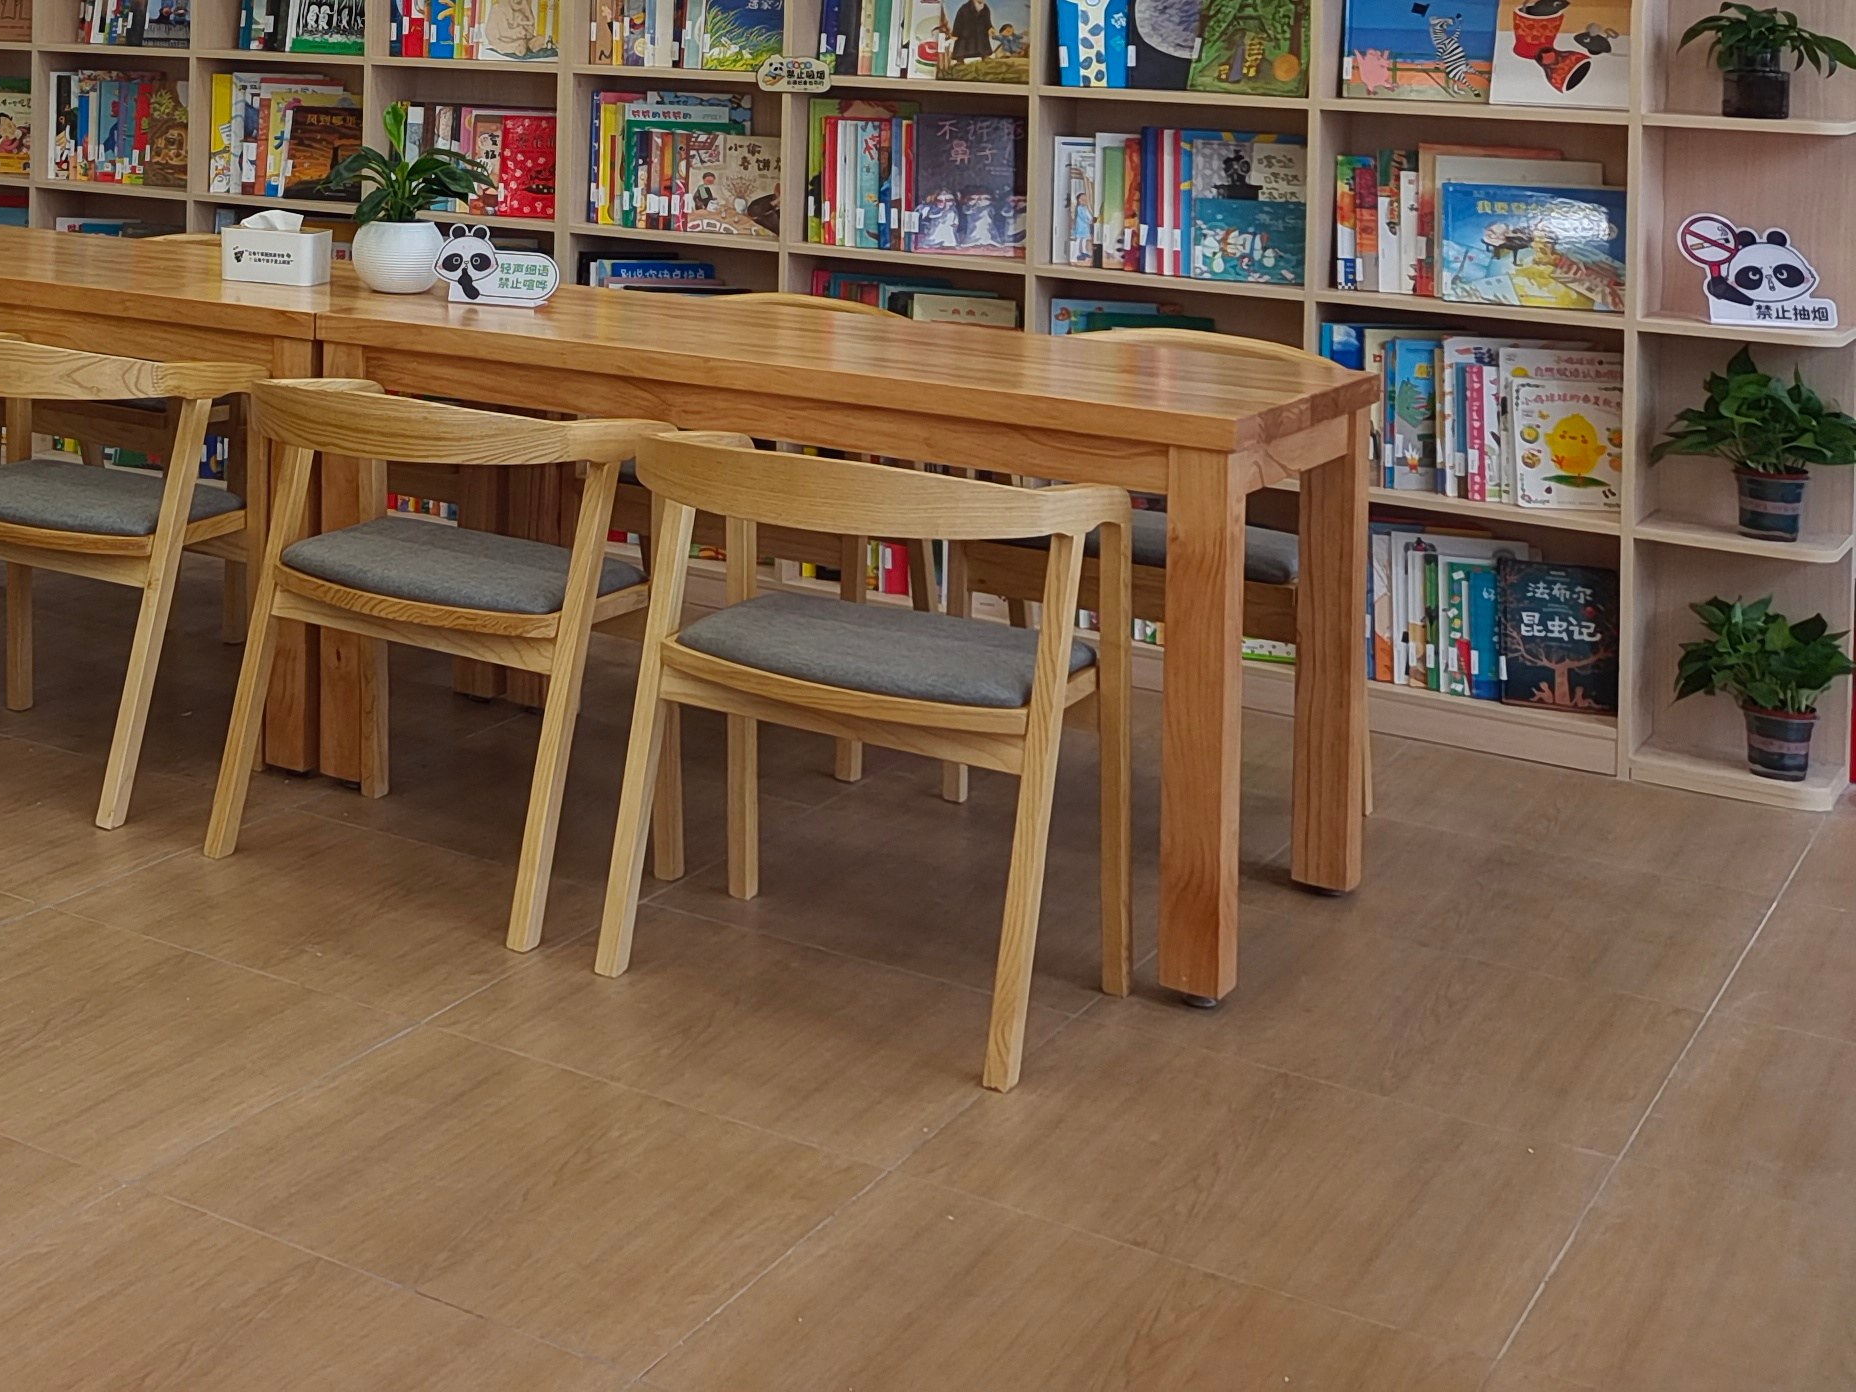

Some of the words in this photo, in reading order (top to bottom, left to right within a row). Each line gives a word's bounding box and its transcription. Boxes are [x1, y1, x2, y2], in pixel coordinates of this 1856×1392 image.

[499, 262, 550, 277] 轻声细语
[497, 277, 548, 292] 禁止喧哗
[1755, 303, 1830, 324] 禁止抽烟
[1526, 580, 1594, 604] 法布尔
[1520, 611, 1603, 642] 昆虫记
